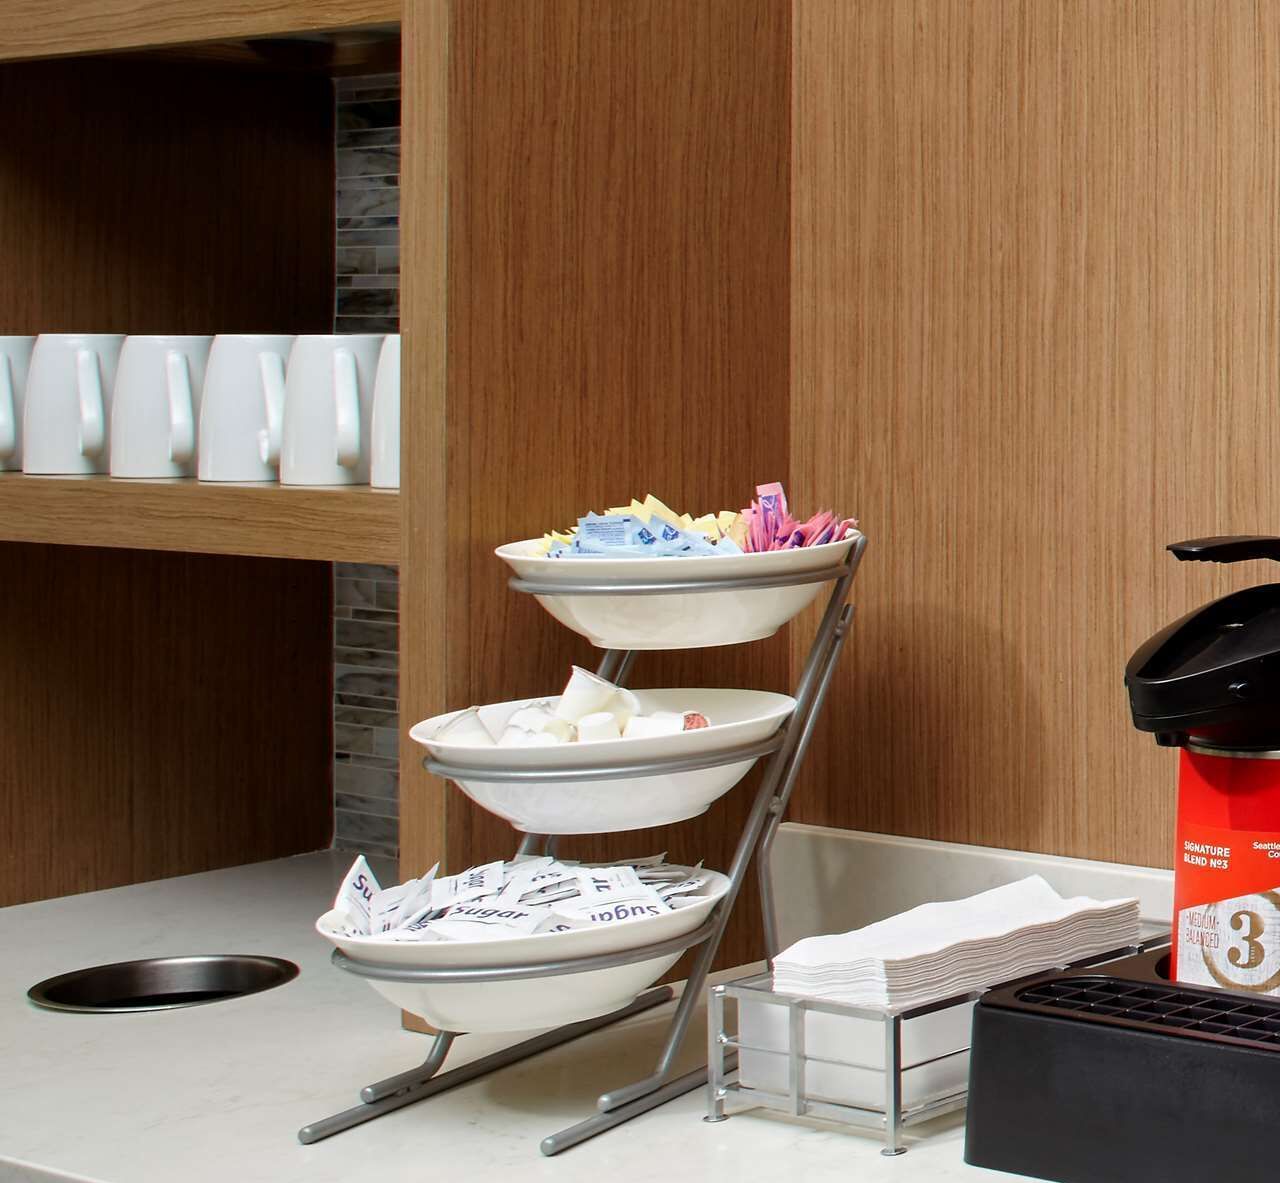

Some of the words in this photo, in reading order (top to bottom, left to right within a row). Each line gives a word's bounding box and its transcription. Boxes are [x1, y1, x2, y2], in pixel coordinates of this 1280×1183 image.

[1184, 841, 1230, 857] SIGNATURE
[1184, 853, 1207, 866] BLEND
[1186, 928, 1219, 948] BALANCED
[1227, 910, 1265, 968] 3
